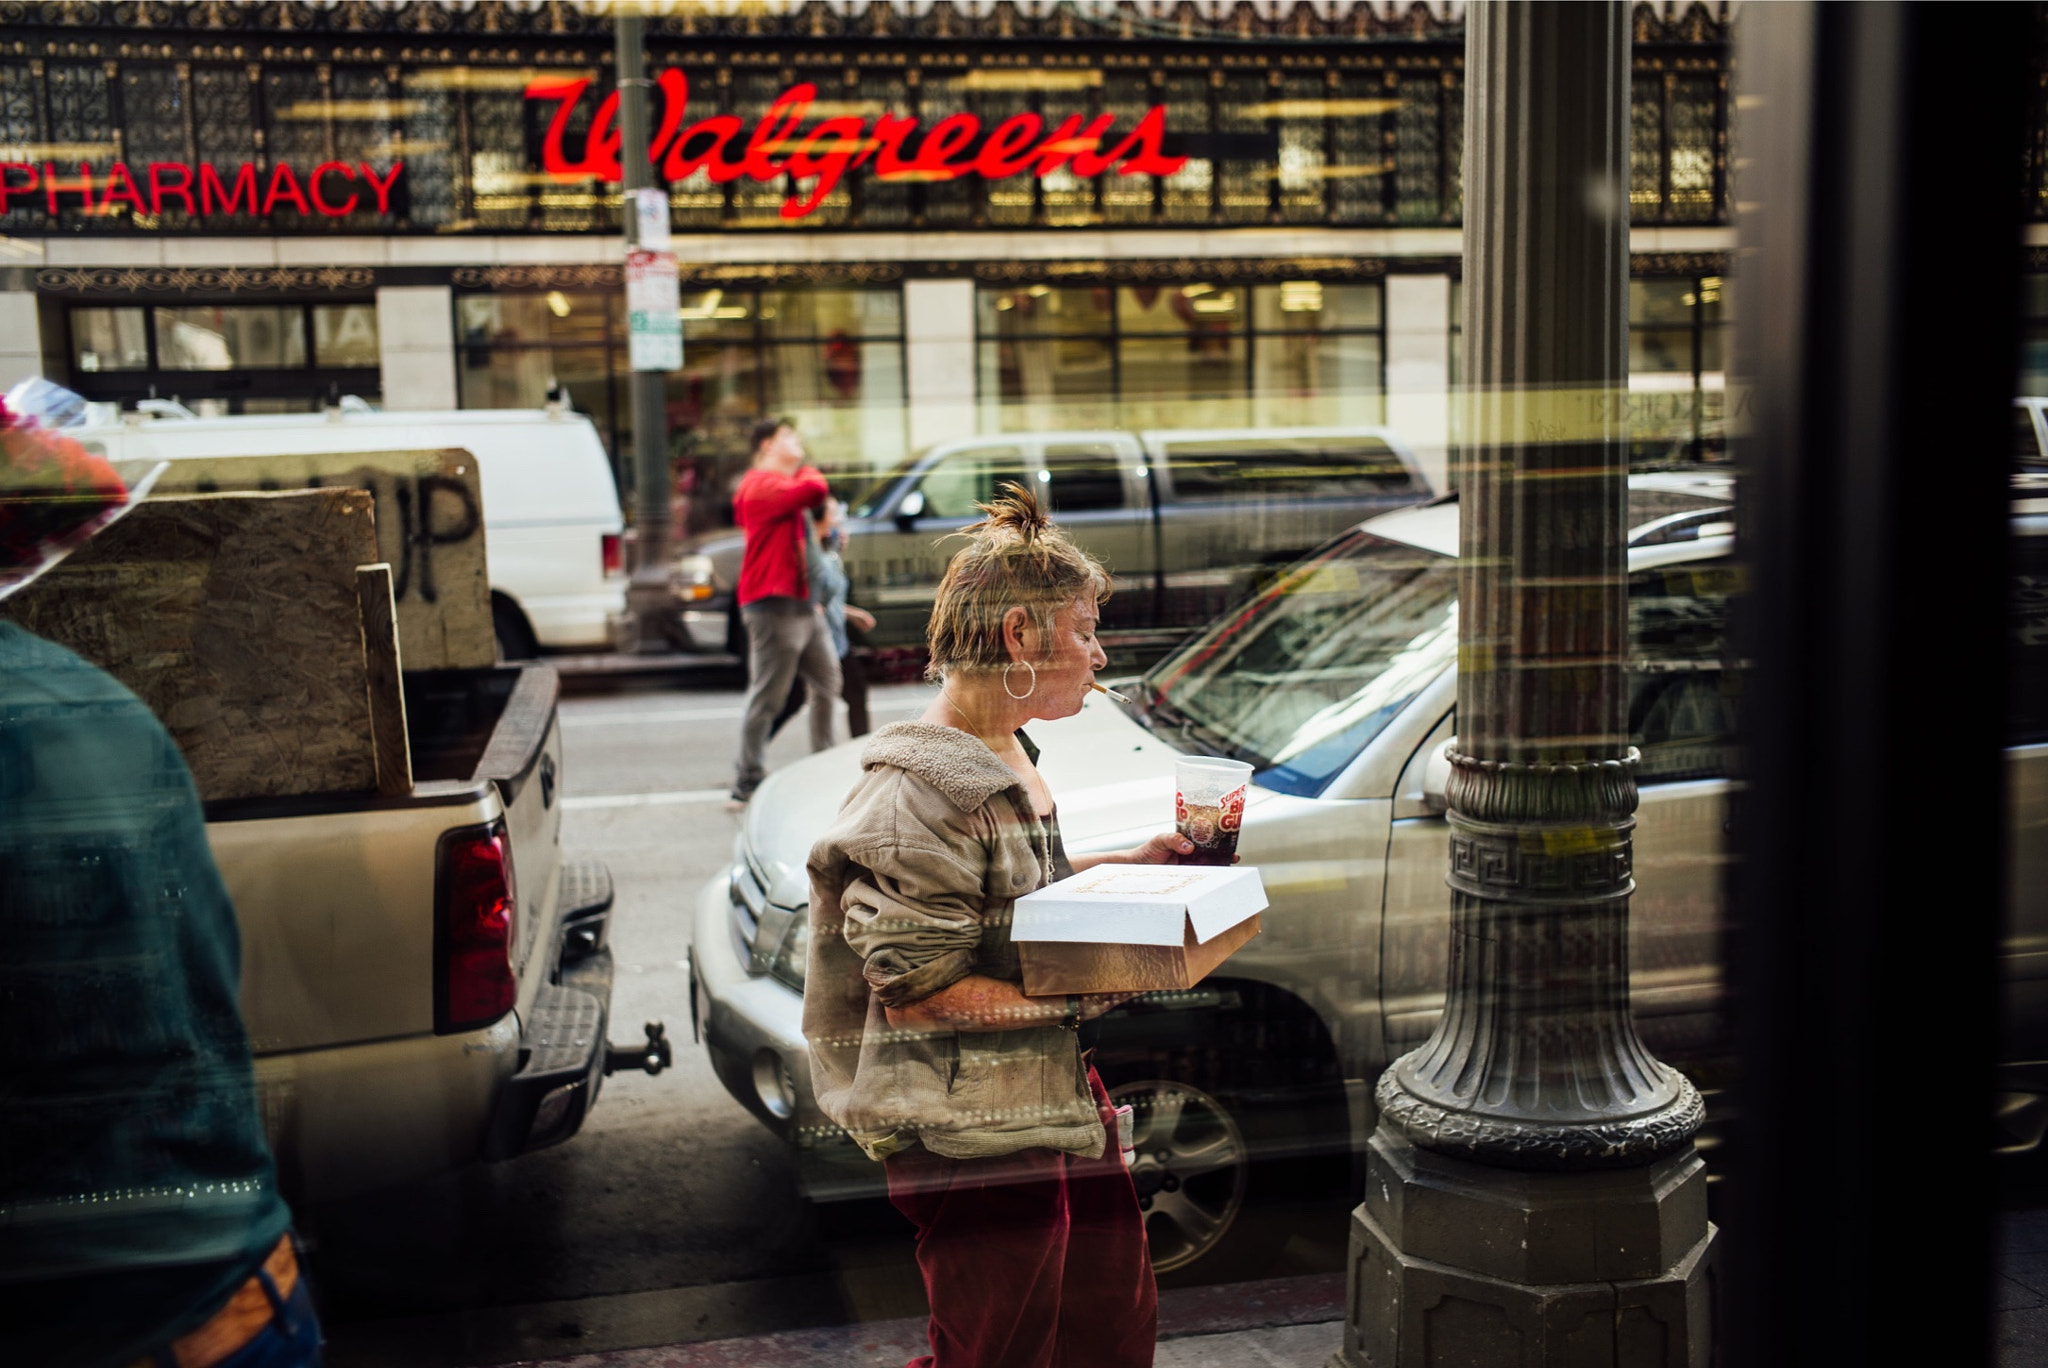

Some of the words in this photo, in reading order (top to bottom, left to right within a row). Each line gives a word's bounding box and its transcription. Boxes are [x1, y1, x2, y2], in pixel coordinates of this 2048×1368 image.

[525, 68, 1189, 219] Walgreens
[0, 161, 404, 217] PHARMACY
[1220, 784, 1246, 810] SUPER
[1220, 813, 1243, 830] GU
